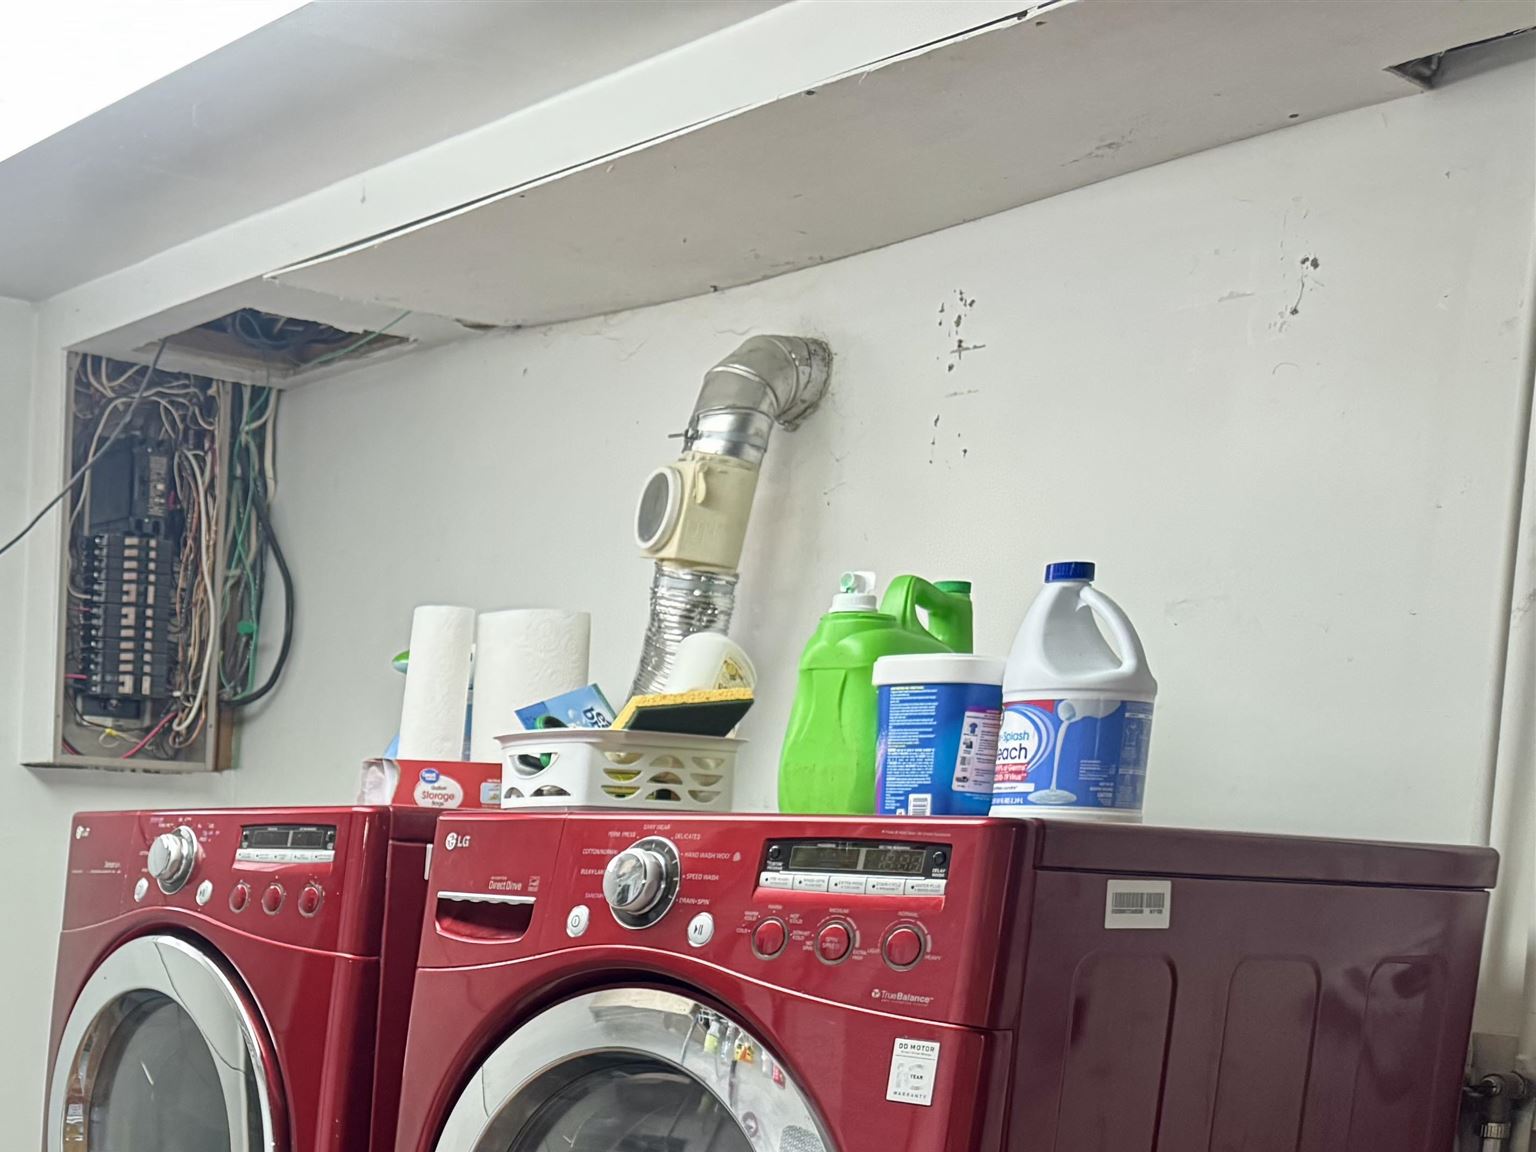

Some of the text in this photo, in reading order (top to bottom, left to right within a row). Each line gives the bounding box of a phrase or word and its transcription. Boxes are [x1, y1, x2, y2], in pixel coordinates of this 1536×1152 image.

[1001, 730, 1030, 743] -Splash
[997, 744, 1028, 761] each
[422, 791, 455, 801] Storage
[910, 1044, 935, 1052] MOTOR
[893, 1091, 927, 1099] WARRANTY
